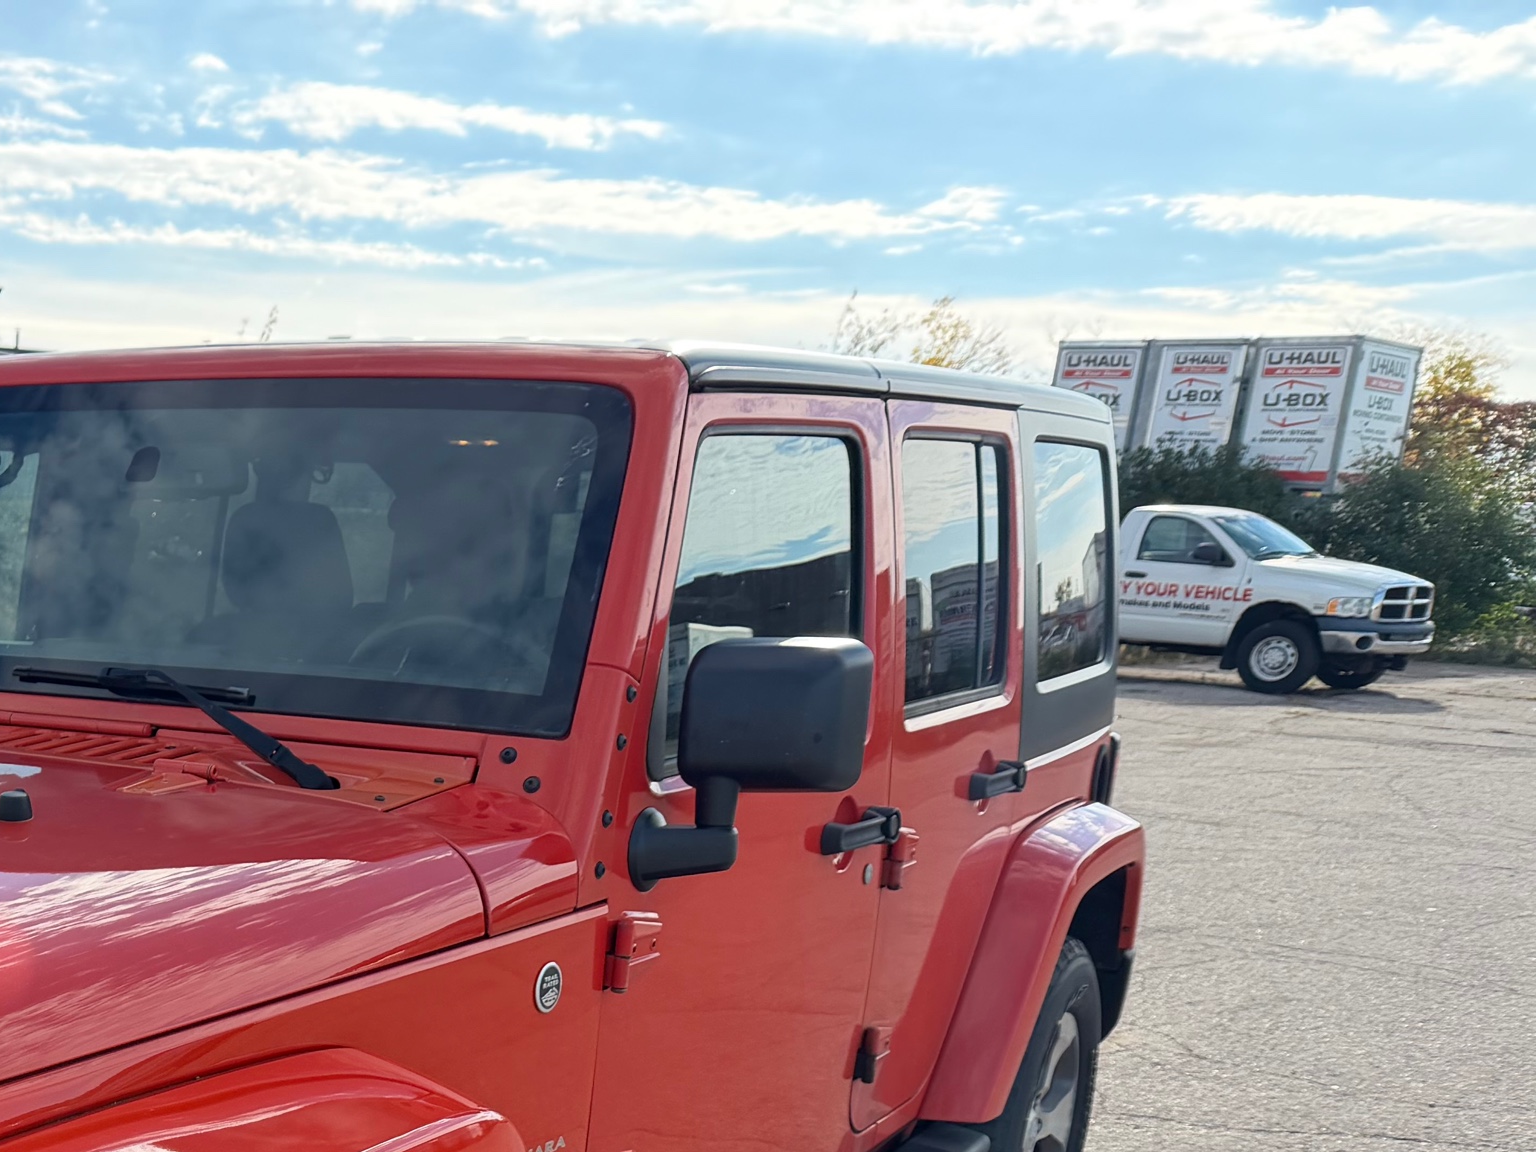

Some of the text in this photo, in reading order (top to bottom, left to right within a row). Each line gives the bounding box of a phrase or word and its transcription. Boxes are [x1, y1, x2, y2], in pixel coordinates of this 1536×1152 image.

[1067, 354, 1133, 367] U-HAUL
[1175, 354, 1229, 365] U-HAUL
[1267, 351, 1342, 365] U-HAUL
[1369, 356, 1407, 379] U-HAUL
[1165, 389, 1224, 402] U-BOX
[1262, 391, 1332, 407] U-BOX
[1135, 580, 1180, 599] YOUR
[1183, 583, 1254, 602] VEHICLE
